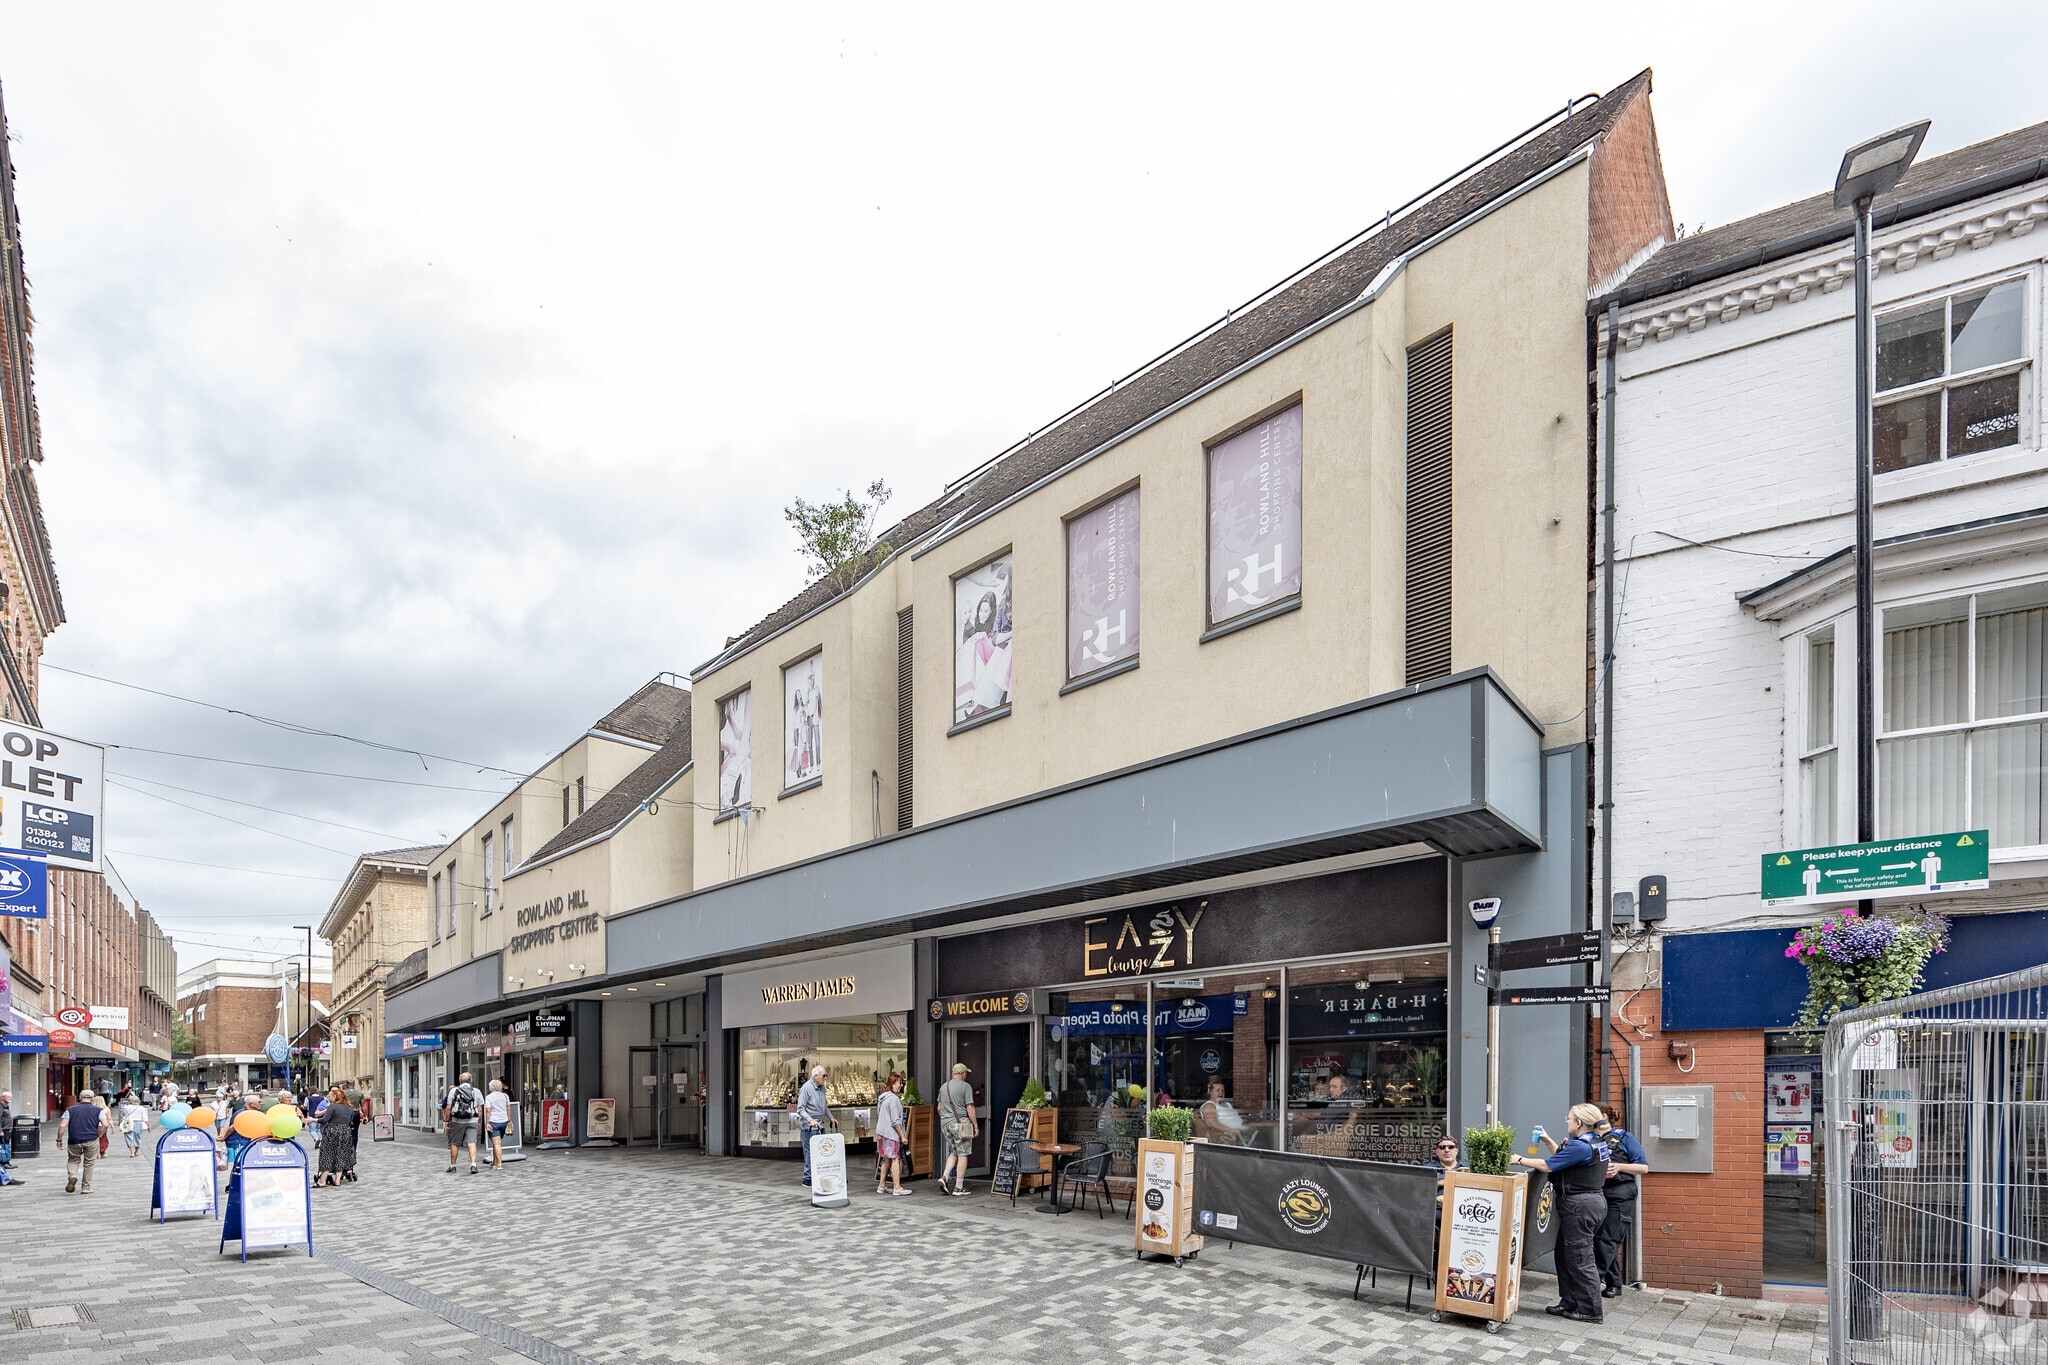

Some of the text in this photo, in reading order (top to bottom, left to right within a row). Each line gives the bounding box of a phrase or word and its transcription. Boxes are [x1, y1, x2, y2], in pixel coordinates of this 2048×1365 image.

[1259, 424, 1270, 535] ROWLAND HILL
[1273, 418, 1282, 530] SHOPPING CENTRE
[1107, 503, 1117, 601] ROWLAND HILL
[1118, 546, 1126, 598] SHOPPING
[1227, 543, 1283, 605] RH
[1082, 608, 1127, 663] RH
[2, 760, 83, 802] LET
[25, 826, 58, 839] 01384
[25, 836, 65, 849] 400123
[1802, 840, 1943, 862] Please keep your distance
[517, 889, 589, 927] ROWLAND HILL
[511, 912, 599, 955] SHOPPING CENTRE
[1108, 956, 1151, 976] lounge
[1546, 956, 1578, 964] Kidderminster
[761, 975, 855, 1005] WARREN JAMES
[946, 997, 1009, 1015] WELCOME
[788, 1032, 808, 1040] SALE
[552, 1110, 560, 1131] SALE
[1293, 1135, 1316, 1143] MEZE
[1325, 1123, 1442, 1138] VEGGIE DISHES
[1769, 1134, 1809, 1142] SAVR
[1325, 1142, 1383, 1151] SANDWICHES
[1384, 1143, 1421, 1152] COFFEE
[1370, 1136, 1401, 1144] TURKISH
[1402, 1137, 1430, 1145] DISHES
[261, 1146, 287, 1156] MAX
[1378, 1151, 1421, 1159] BREAKFAST
[1282, 1179, 1329, 1198] EAZY LOUNGE
[1475, 1196, 1492, 1204] LOUNGE
[1459, 1203, 1495, 1224] Gelato
[1312, 1218, 1329, 1234] DELIGHT
